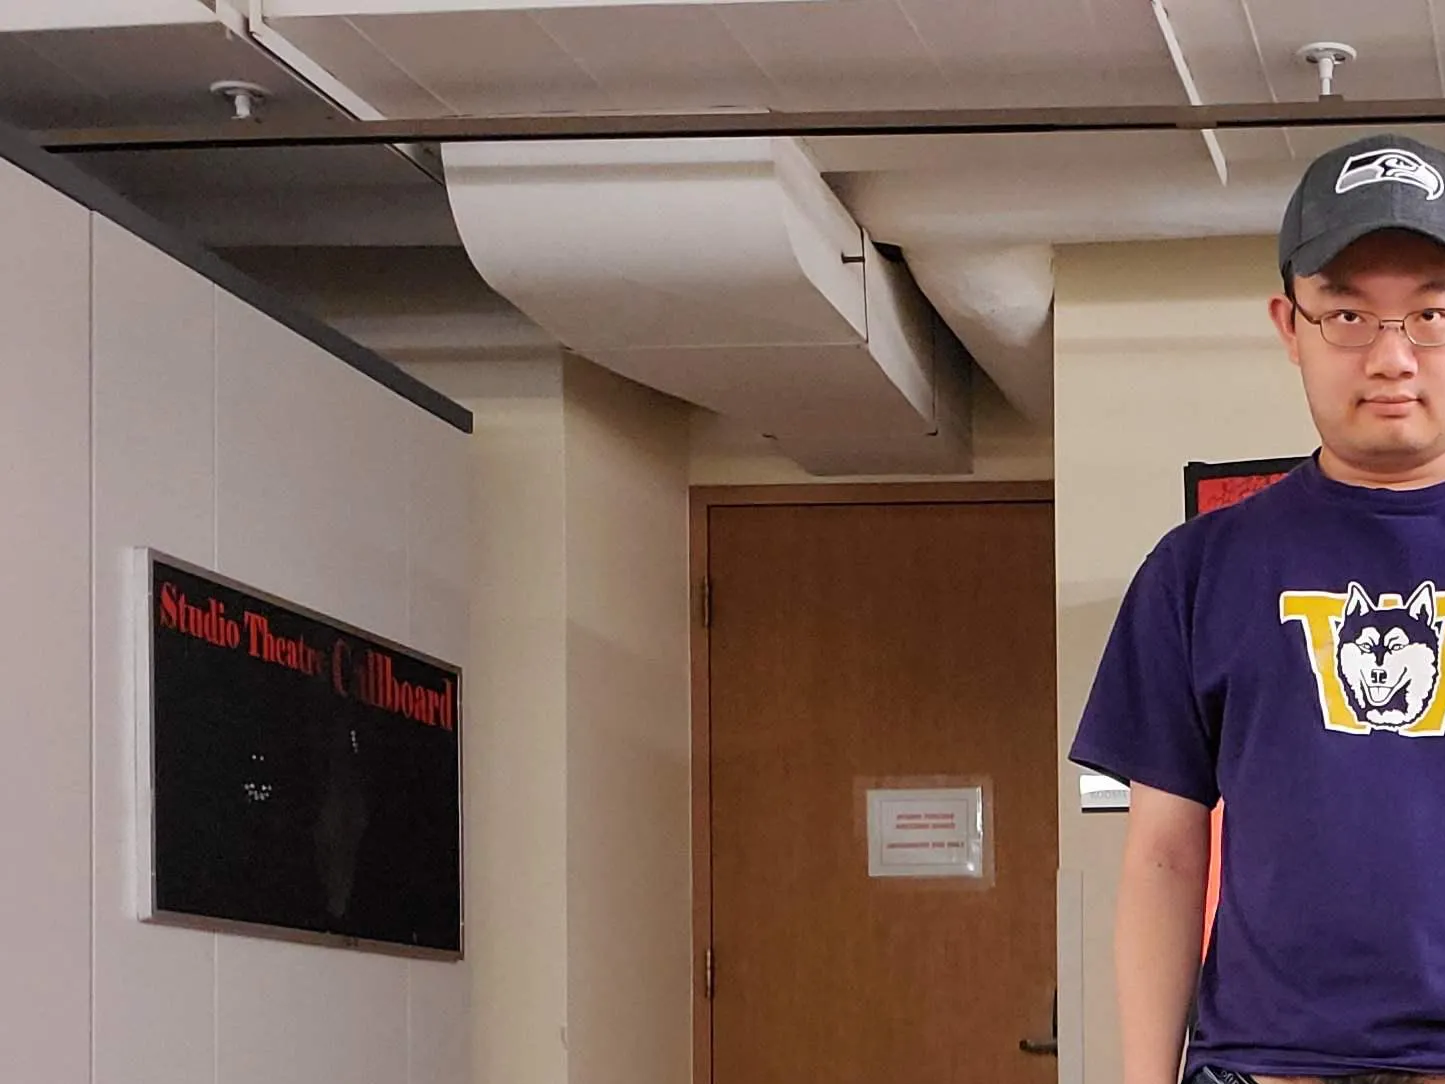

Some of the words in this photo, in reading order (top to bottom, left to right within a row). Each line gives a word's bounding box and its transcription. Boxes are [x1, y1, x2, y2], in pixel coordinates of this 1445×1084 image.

[160, 582, 241, 649] Studio
[243, 611, 328, 678] Theatr
[331, 637, 453, 732] Cllboard
